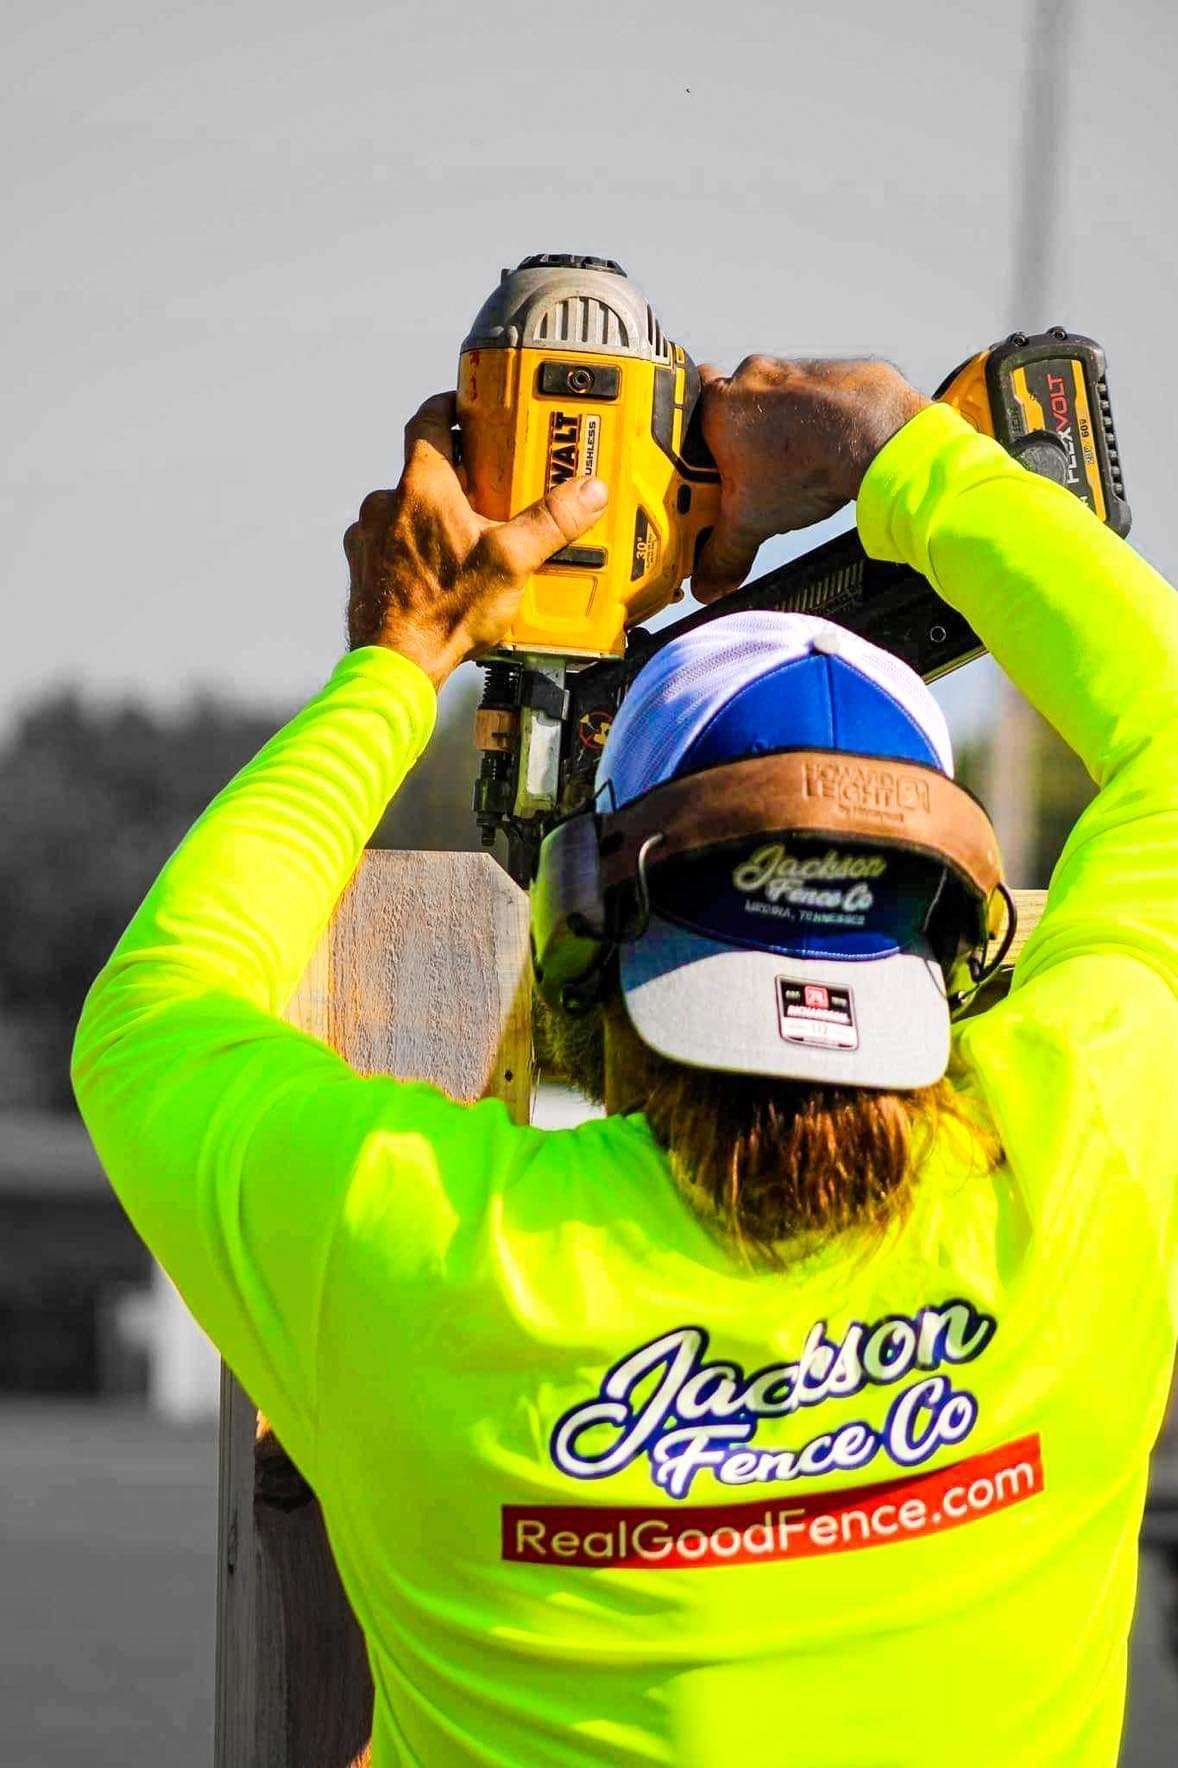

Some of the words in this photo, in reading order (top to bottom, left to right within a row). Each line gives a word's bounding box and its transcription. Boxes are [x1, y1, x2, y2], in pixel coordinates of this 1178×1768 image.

[549, 412, 579, 491] WALT
[585, 420, 596, 477] USHLESS
[733, 842, 887, 891] Jackson
[765, 878, 842, 908] Fence
[843, 881, 874, 912] Co
[551, 1299, 996, 1479] Jackson
[651, 1423, 878, 1498] Fence
[884, 1376, 978, 1466] Co
[515, 1460, 1036, 1561] RealGoodFence.com
